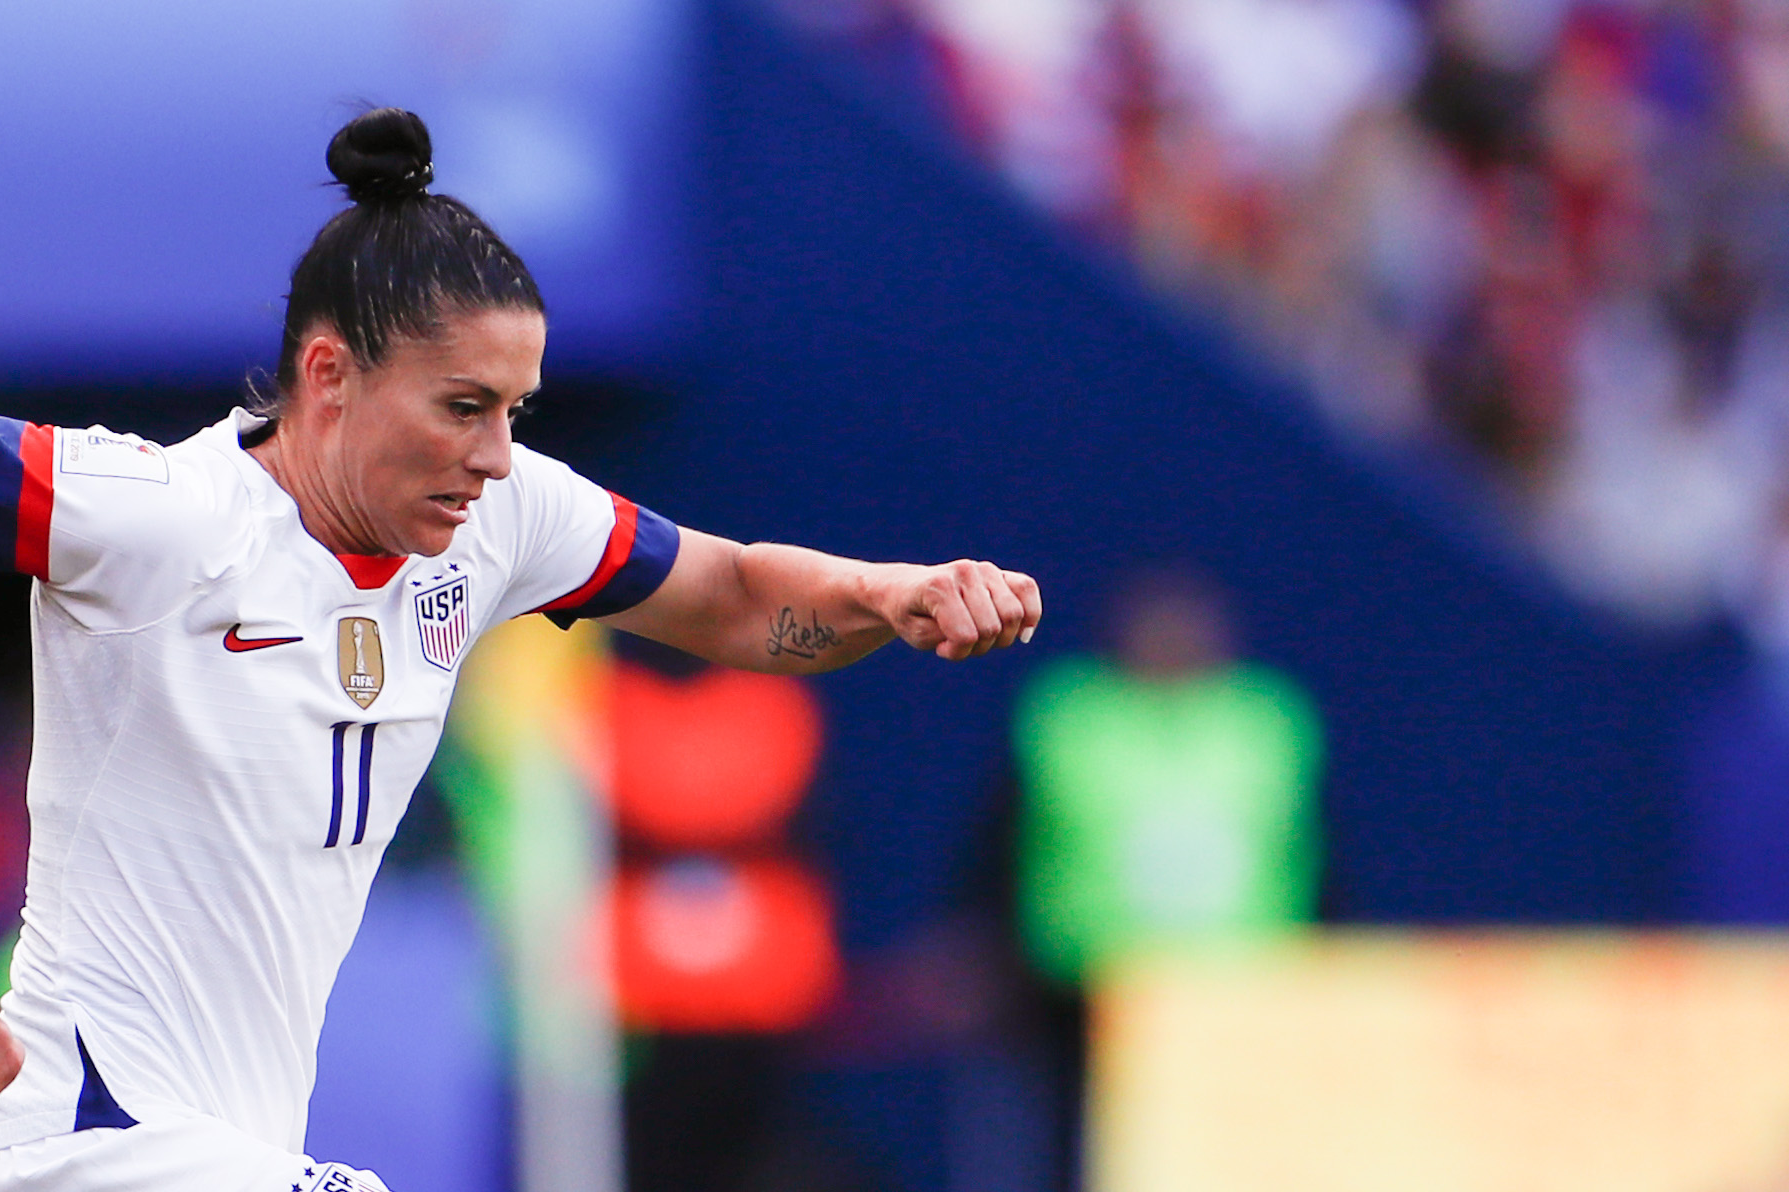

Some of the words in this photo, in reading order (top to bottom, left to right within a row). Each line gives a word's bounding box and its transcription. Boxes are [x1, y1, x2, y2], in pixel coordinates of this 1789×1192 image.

[421, 585, 463, 621] USA
[767, 606, 842, 659] Liebe
[350, 675, 373, 687] FIFA
[323, 722, 377, 848] 11
